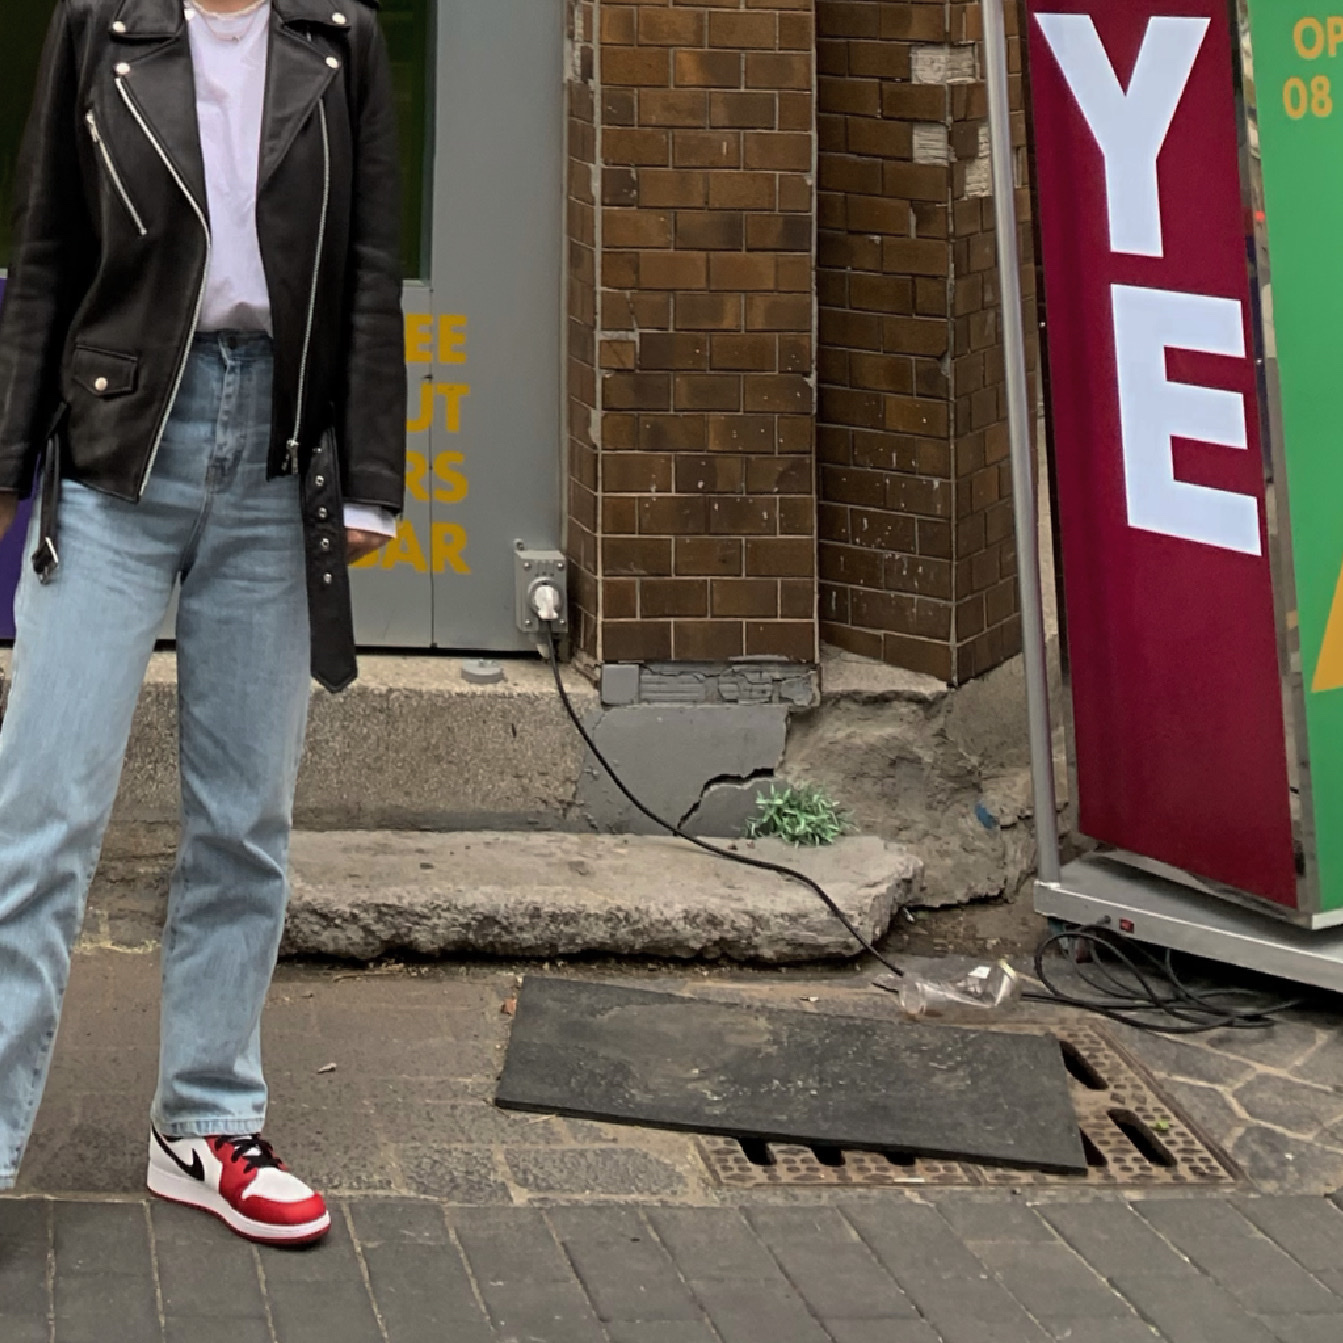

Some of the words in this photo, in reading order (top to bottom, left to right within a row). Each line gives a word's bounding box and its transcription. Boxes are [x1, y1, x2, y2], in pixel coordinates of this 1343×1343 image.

[1293, 15, 1343, 59] OP
[1282, 76, 1333, 118] 08
[1033, 11, 1262, 556] YE
[404, 313, 467, 364] EE
[405, 382, 471, 433] UT
[404, 450, 468, 503] RS
[350, 520, 471, 574] AR
